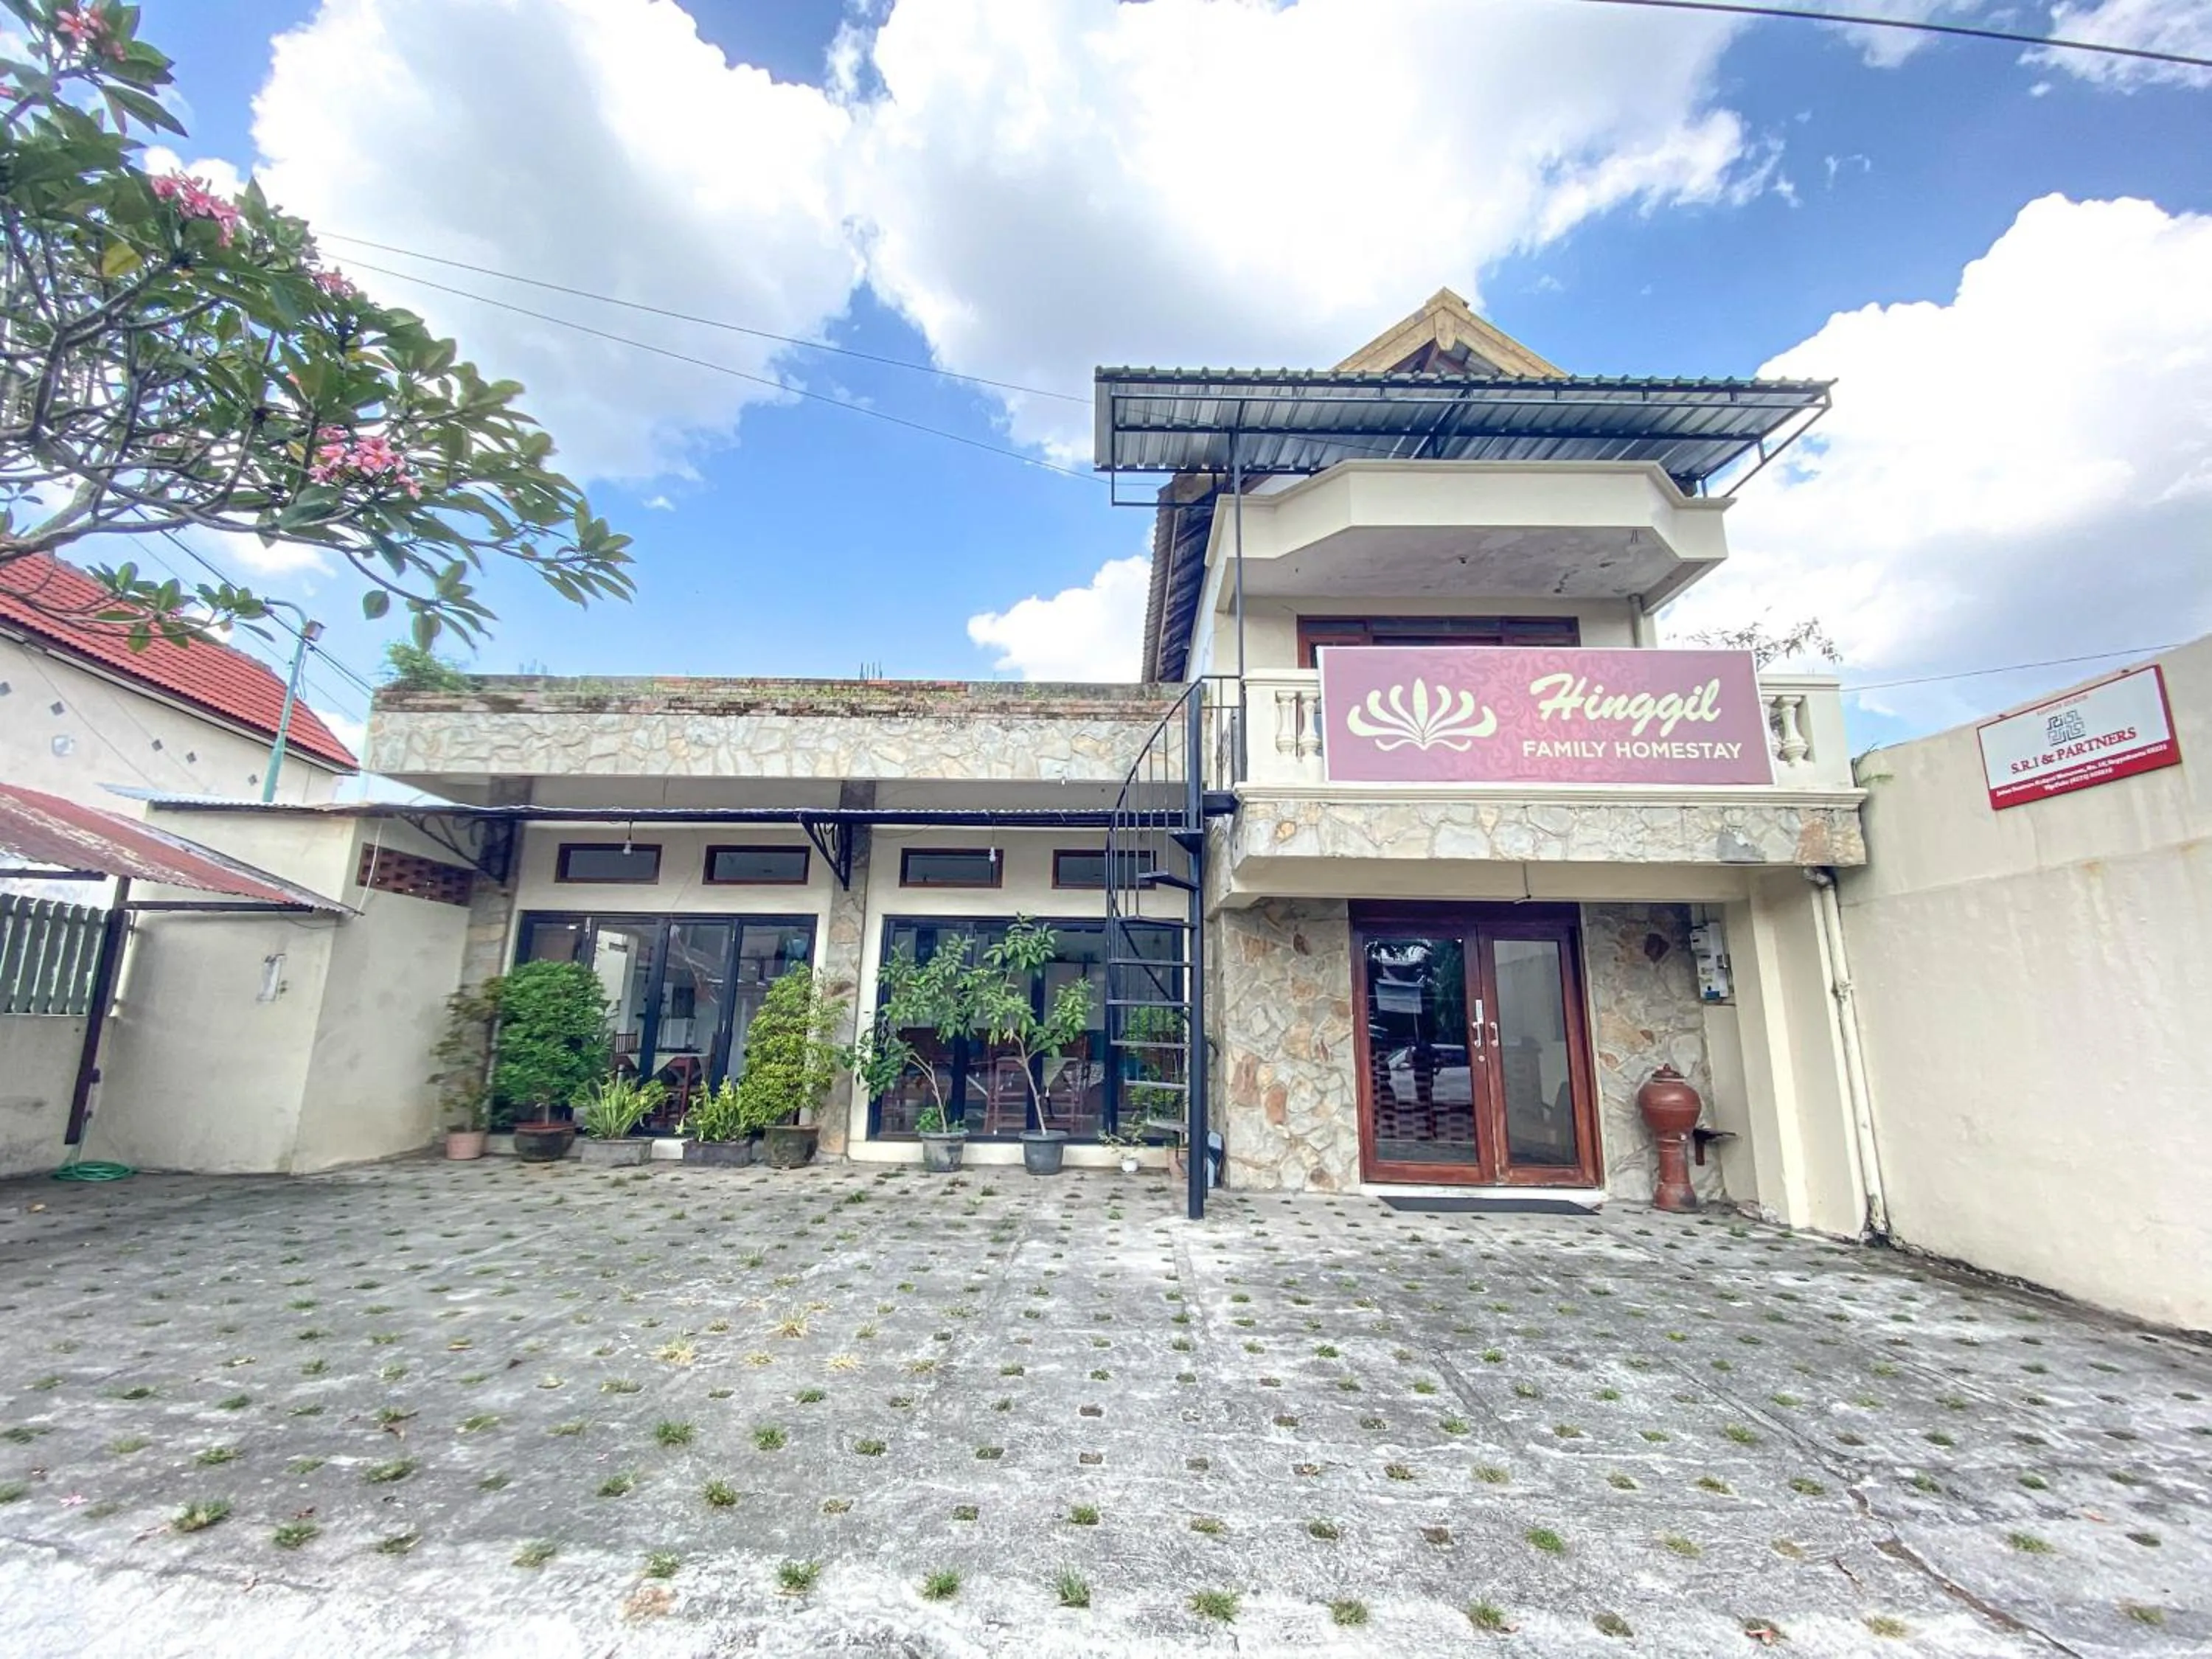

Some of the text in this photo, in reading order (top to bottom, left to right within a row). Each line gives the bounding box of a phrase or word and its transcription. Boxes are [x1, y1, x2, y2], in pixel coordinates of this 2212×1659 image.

[1529, 672, 1721, 738] Hinggil
[1523, 740, 1743, 760] FAMILY HOMESTAY
[2041, 754, 2054, 765] &
[2055, 727, 2137, 760] PARTNERS
